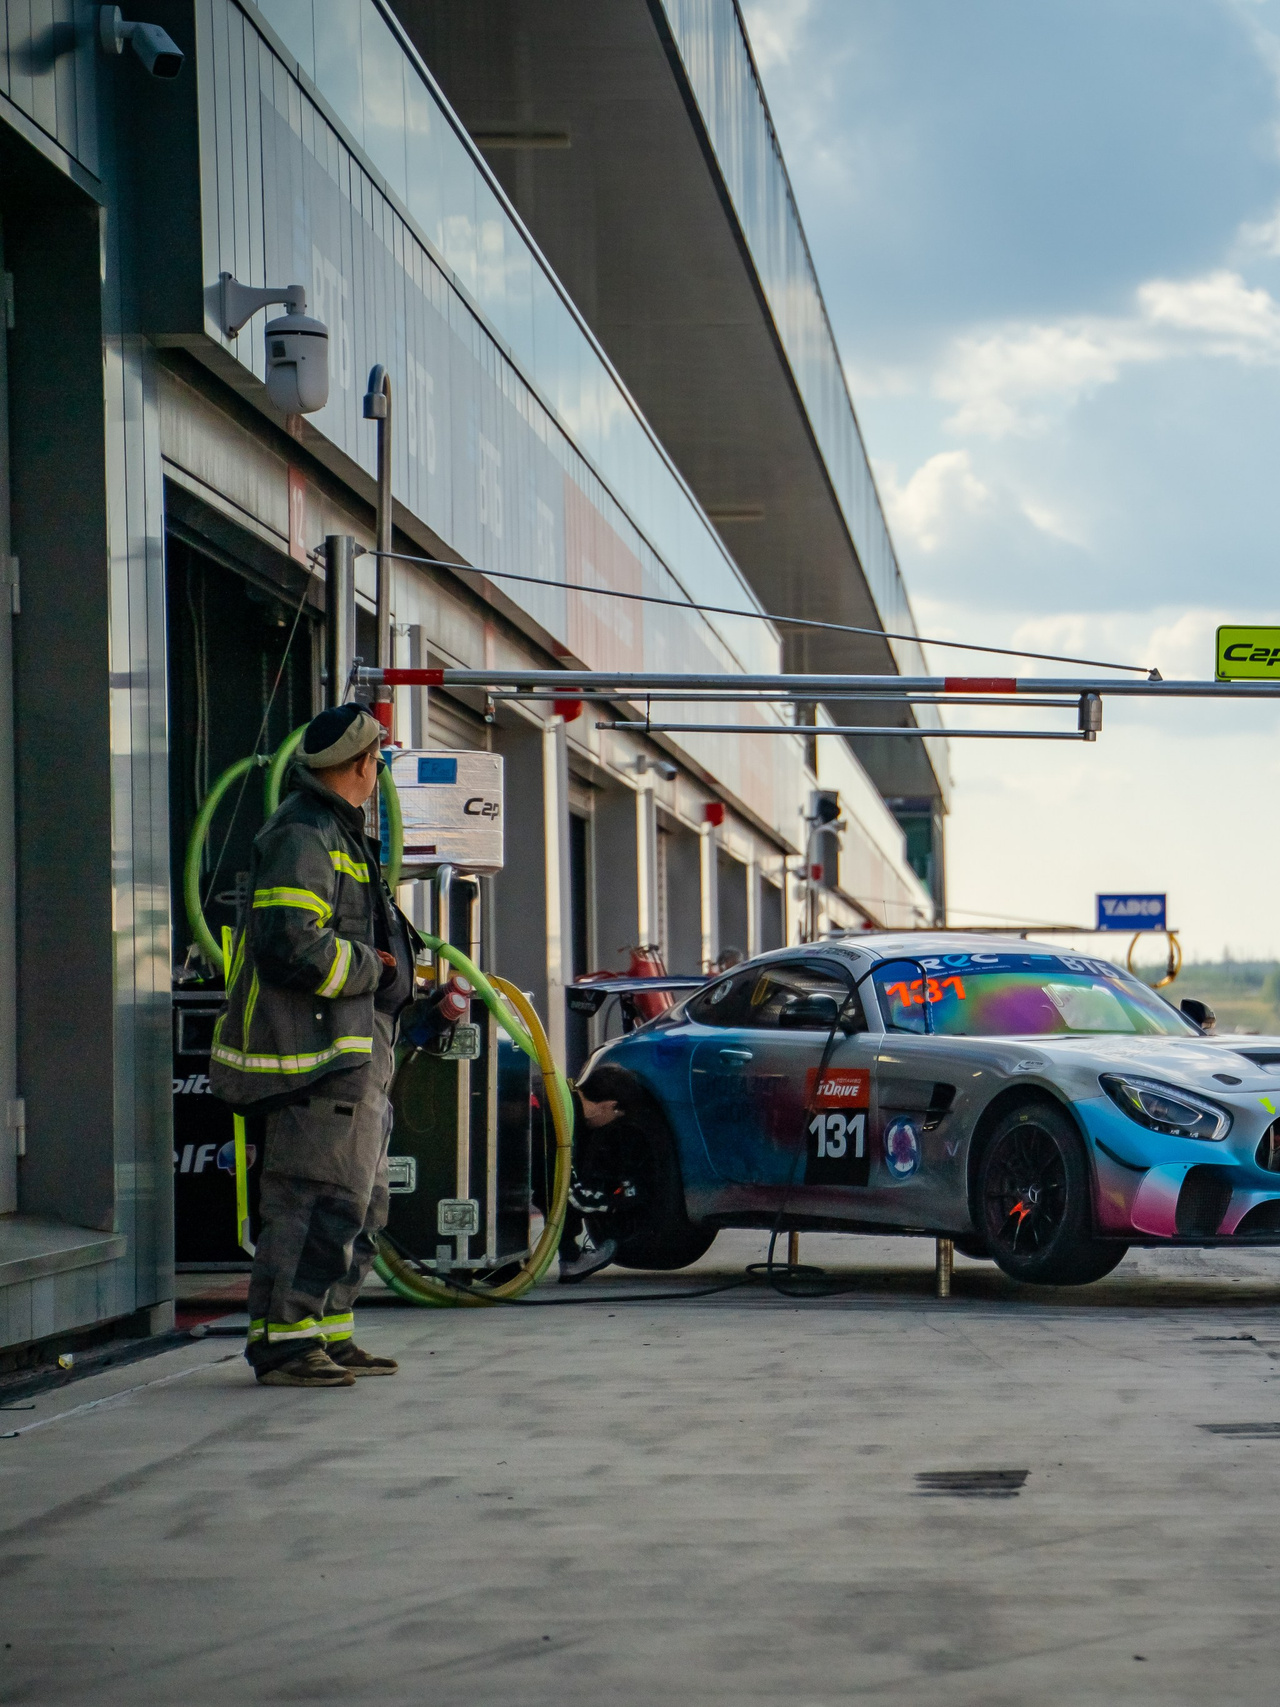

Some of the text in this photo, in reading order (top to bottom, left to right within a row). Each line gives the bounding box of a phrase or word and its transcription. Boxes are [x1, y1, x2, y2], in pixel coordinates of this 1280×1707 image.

[1056, 954, 1120, 980] ВТБ
[886, 975, 966, 1008] 131
[808, 1113, 865, 1158] 131
